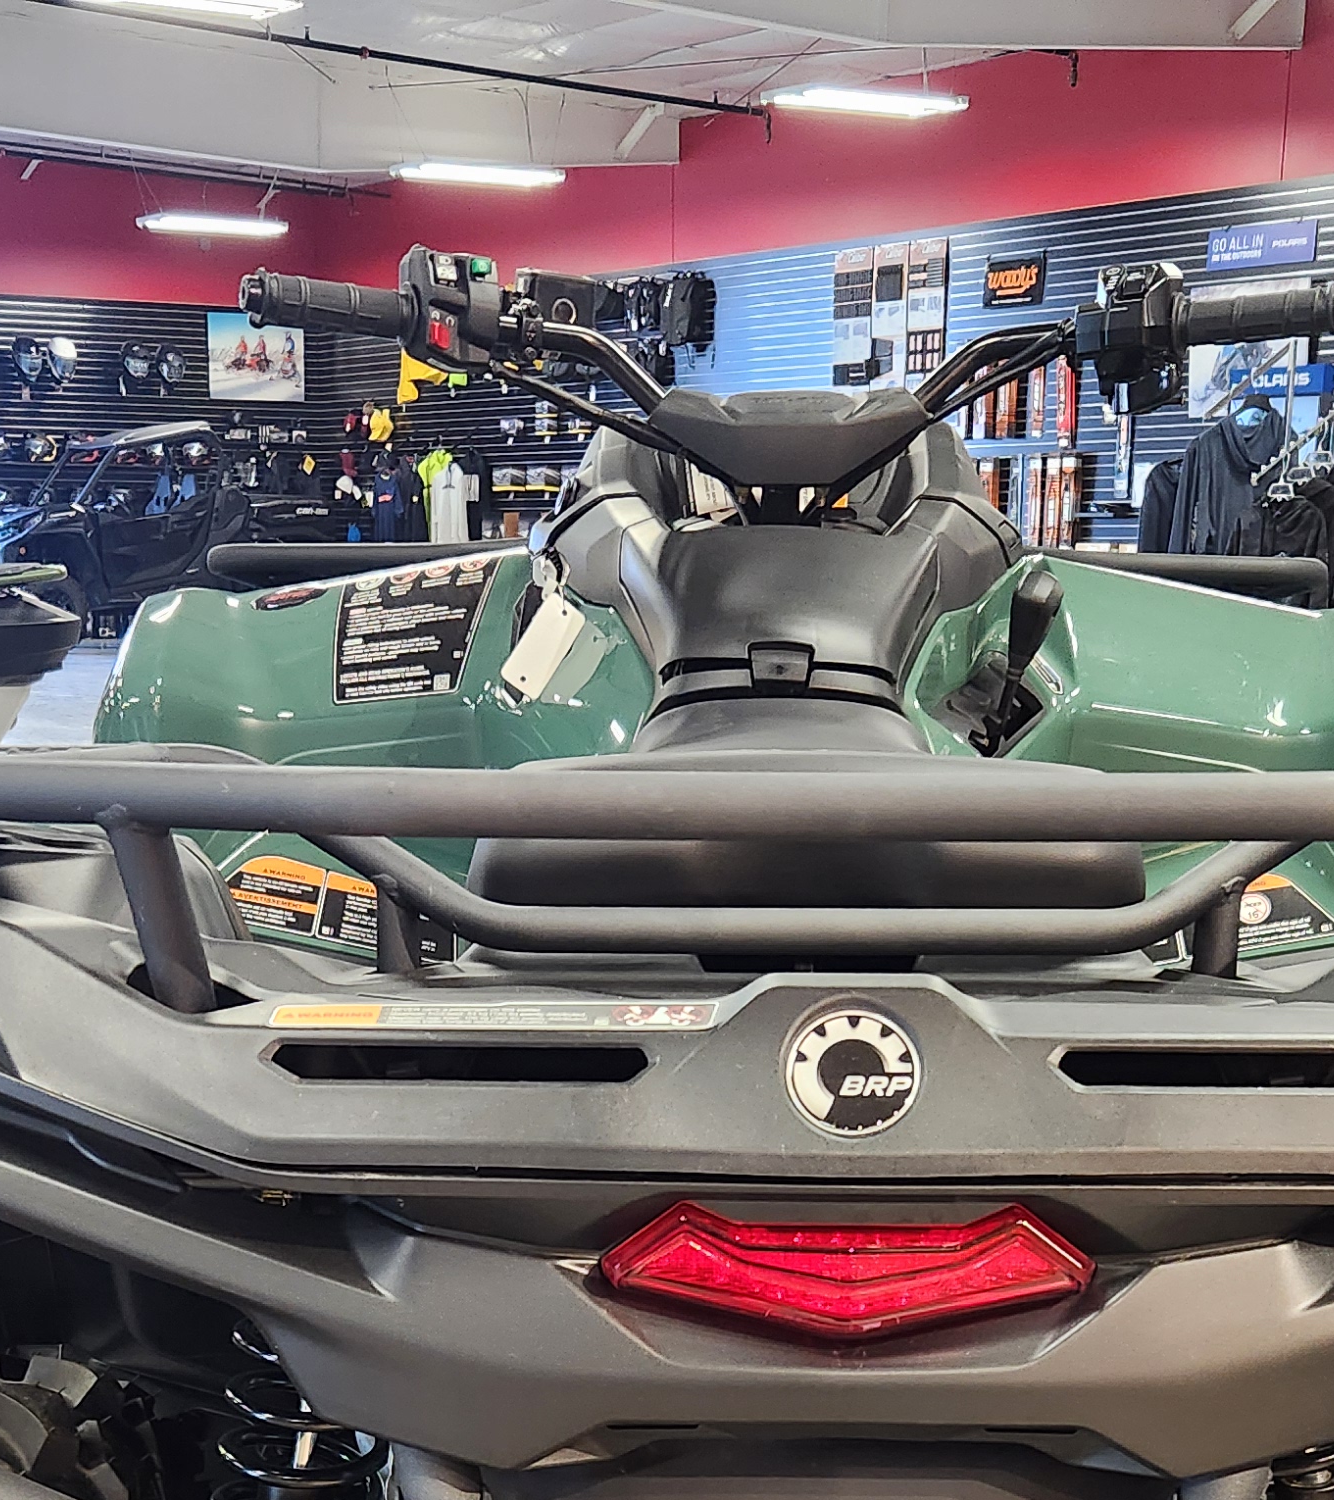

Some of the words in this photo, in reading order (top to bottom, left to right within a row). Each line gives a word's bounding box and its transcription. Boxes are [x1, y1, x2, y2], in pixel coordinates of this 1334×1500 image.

[1212, 238, 1227, 252] GO
[1228, 235, 1249, 250] ALL
[1251, 233, 1264, 248] IN
[297, 1010, 375, 1020] WARNING
[838, 1074, 913, 1097] BRP
